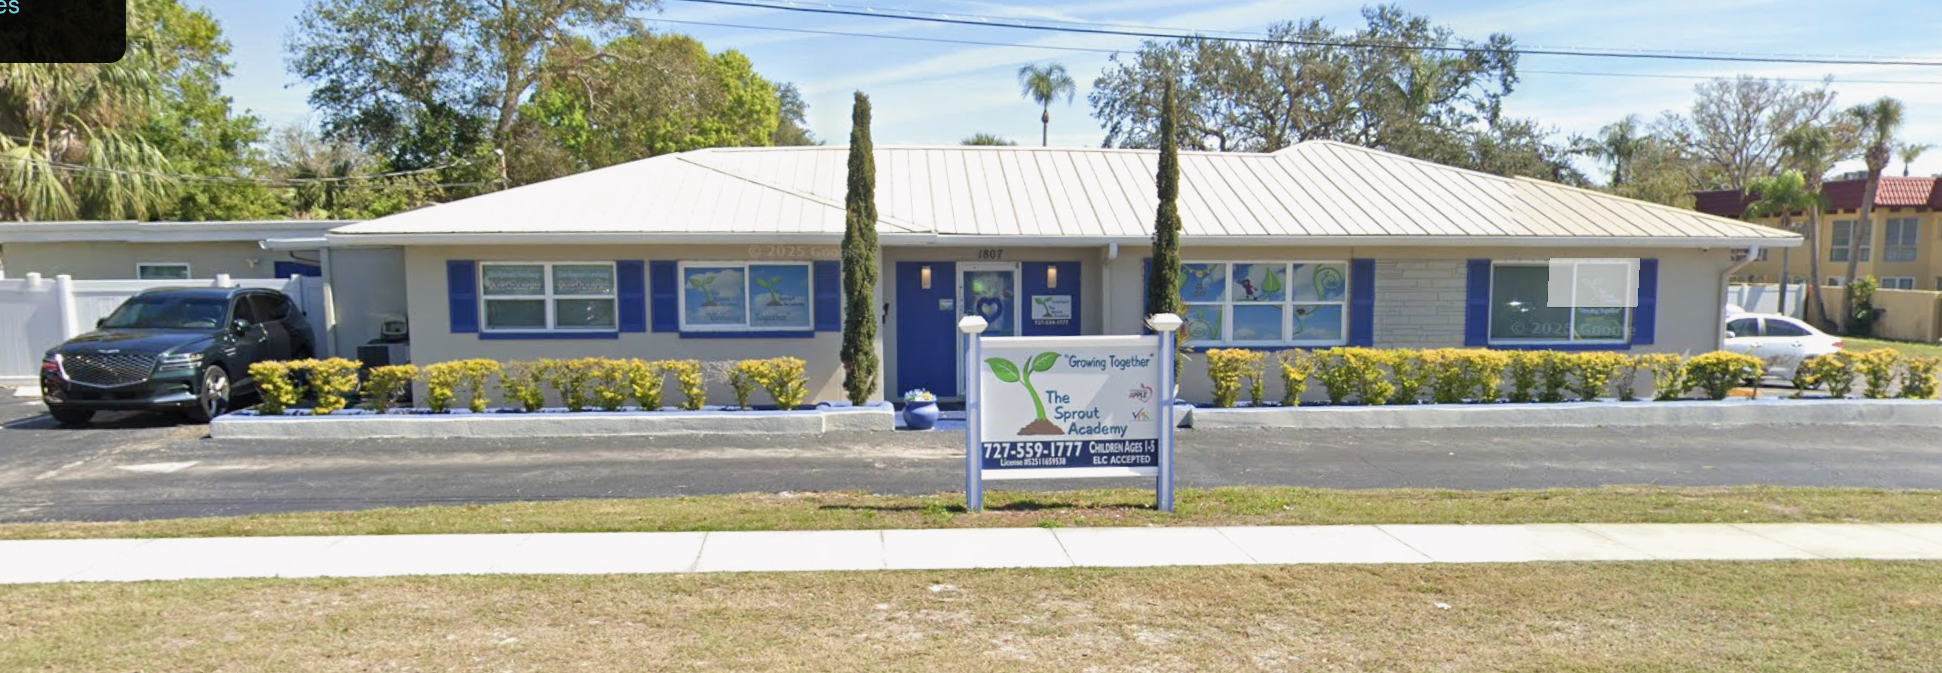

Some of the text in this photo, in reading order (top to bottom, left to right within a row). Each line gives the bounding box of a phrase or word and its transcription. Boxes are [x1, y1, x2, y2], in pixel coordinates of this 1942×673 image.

[978, 249, 1003, 259] 1807
[1064, 353, 1155, 370] "Growing Together"
[1046, 390, 1070, 404] The
[1054, 407, 1100, 421] Sprout
[1067, 422, 1128, 437] Academy
[984, 441, 1083, 458] 727-559-1777
[1144, 440, 1156, 452] 1-5
[1000, 457, 1023, 467] License
[1093, 455, 1151, 465] ELC ACCEPTED
